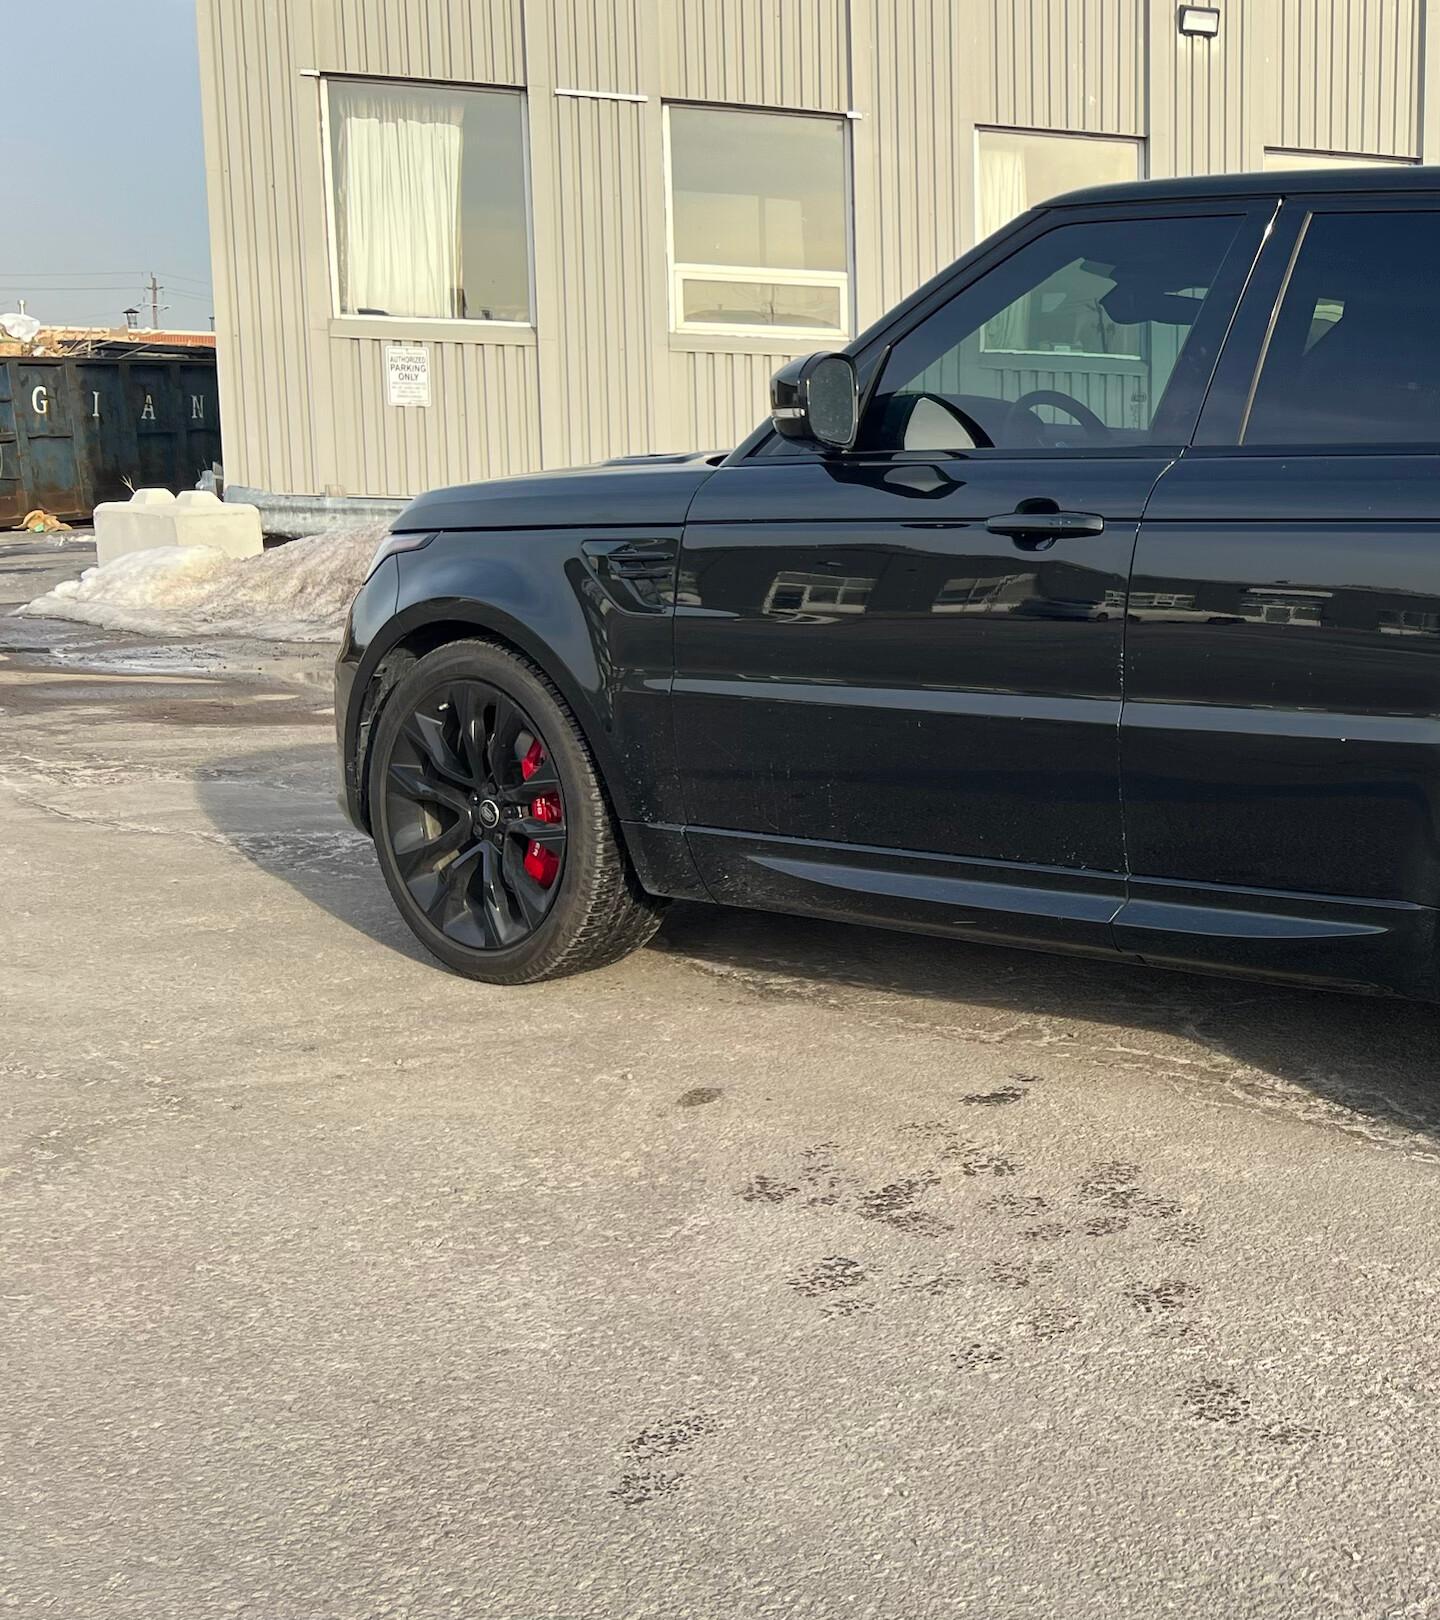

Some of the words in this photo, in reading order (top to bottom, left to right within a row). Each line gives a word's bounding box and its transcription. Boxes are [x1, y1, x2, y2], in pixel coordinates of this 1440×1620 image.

[390, 356, 426, 364] AUTHORIZED
[390, 364, 426, 373] PARKING
[398, 373, 419, 381] ONLY
